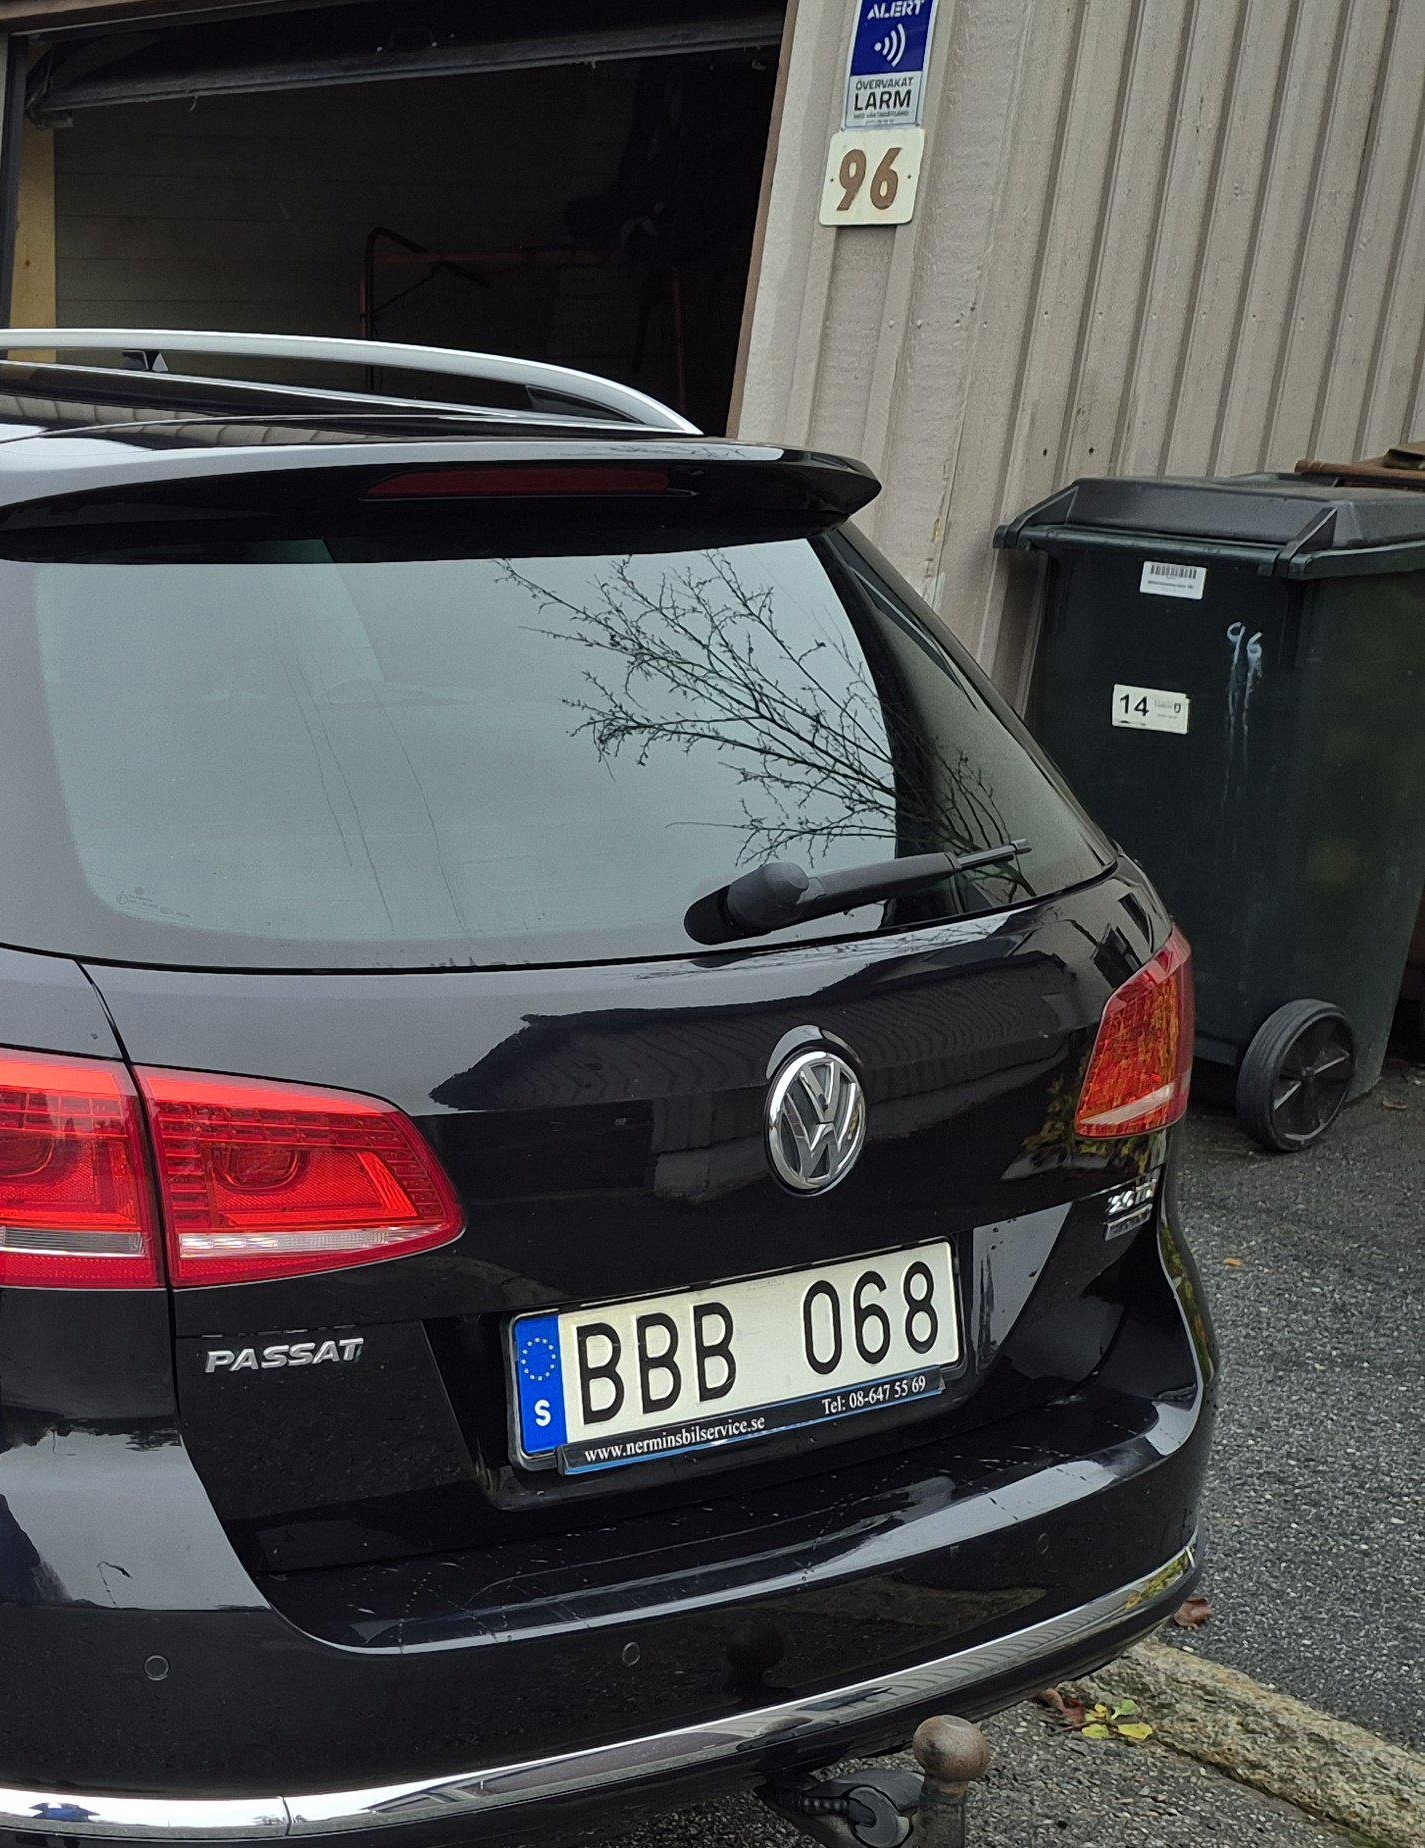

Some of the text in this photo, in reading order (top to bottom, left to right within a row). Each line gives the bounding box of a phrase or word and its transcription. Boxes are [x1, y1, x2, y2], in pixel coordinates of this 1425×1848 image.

[867, 0, 924, 20] ALERT
[854, 89, 911, 111] LARM
[836, 147, 902, 211] 96
[1119, 694, 1149, 716] 14
[205, 1338, 364, 1373] PASSAT
[576, 1261, 938, 1425] BBB 068
[821, 1375, 926, 1415] Tel: 08-647 55 69
[534, 1399, 551, 1427] S
[584, 1416, 766, 1463] www.nerminsbilservice.se
